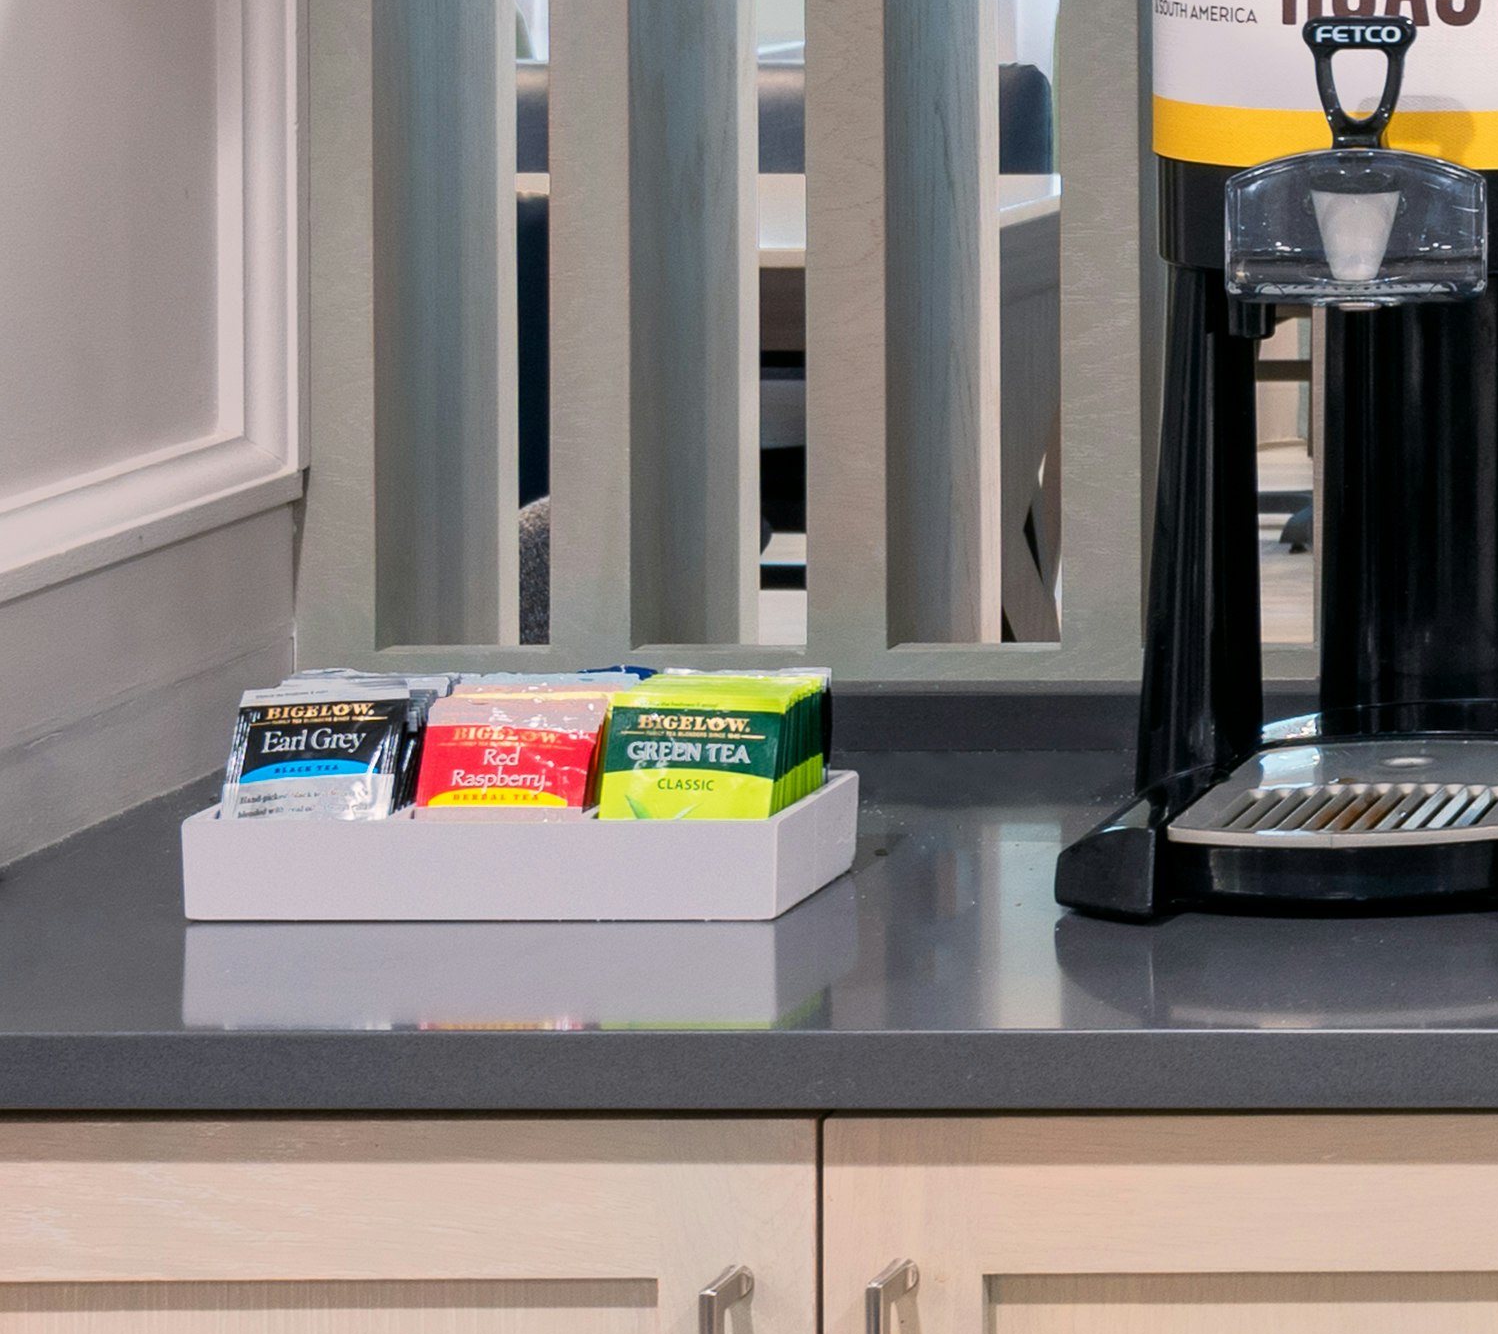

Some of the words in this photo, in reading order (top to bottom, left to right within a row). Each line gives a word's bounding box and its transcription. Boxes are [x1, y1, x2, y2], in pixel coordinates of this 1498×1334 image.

[1190, 4, 1257, 24] AMERICA
[1315, 26, 1402, 43] FETCO
[261, 730, 307, 753] Earl
[311, 728, 367, 753] Grey
[483, 747, 521, 766] Red
[627, 740, 702, 762] GREEN
[705, 743, 751, 764] TEA
[274, 765, 311, 774] BLACK
[317, 764, 339, 772] TEA
[451, 766, 547, 796] Raspberry
[657, 778, 714, 791] CLASSIC
[453, 793, 506, 801] HERBAL
[514, 793, 539, 801] TEA
